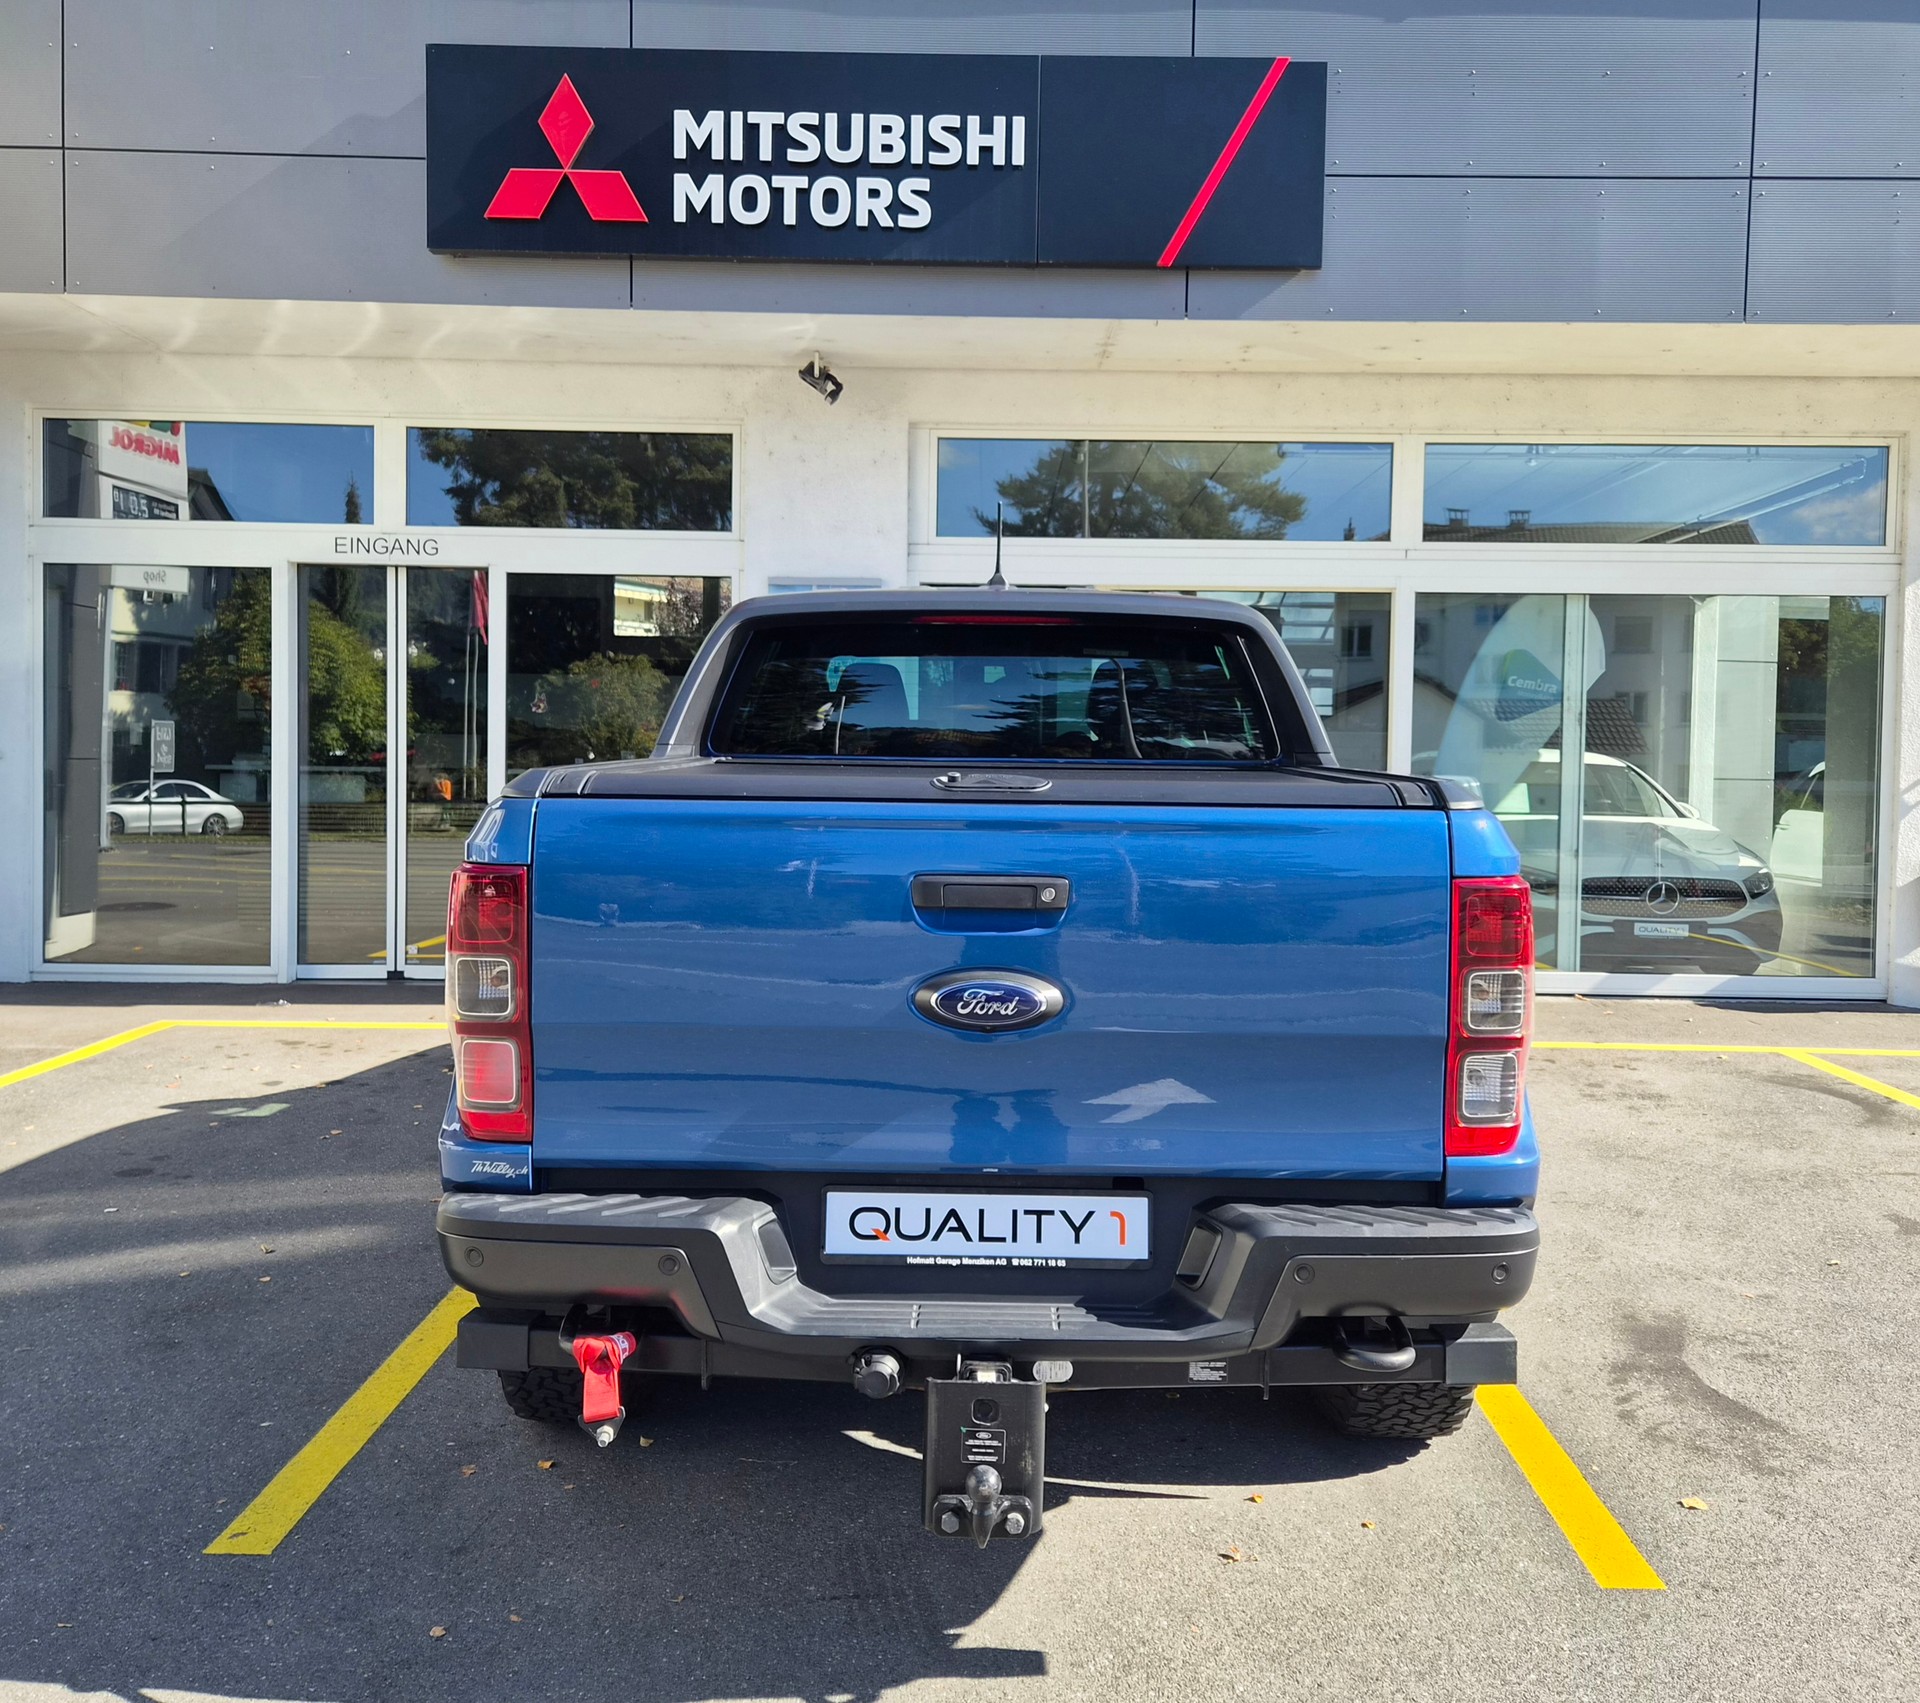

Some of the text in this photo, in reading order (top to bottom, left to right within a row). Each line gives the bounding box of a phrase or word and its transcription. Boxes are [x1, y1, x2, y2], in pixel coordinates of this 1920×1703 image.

[672, 109, 1026, 167] MITSUBISHI
[672, 173, 932, 229] MOTORS
[334, 536, 440, 556] EINGANG
[1507, 675, 1558, 694] Cembra
[957, 989, 1019, 1015] Ford
[848, 1206, 1127, 1246] QUALITY 1
[935, 1256, 961, 1266] Garage
[995, 1257, 1007, 1266] AG
